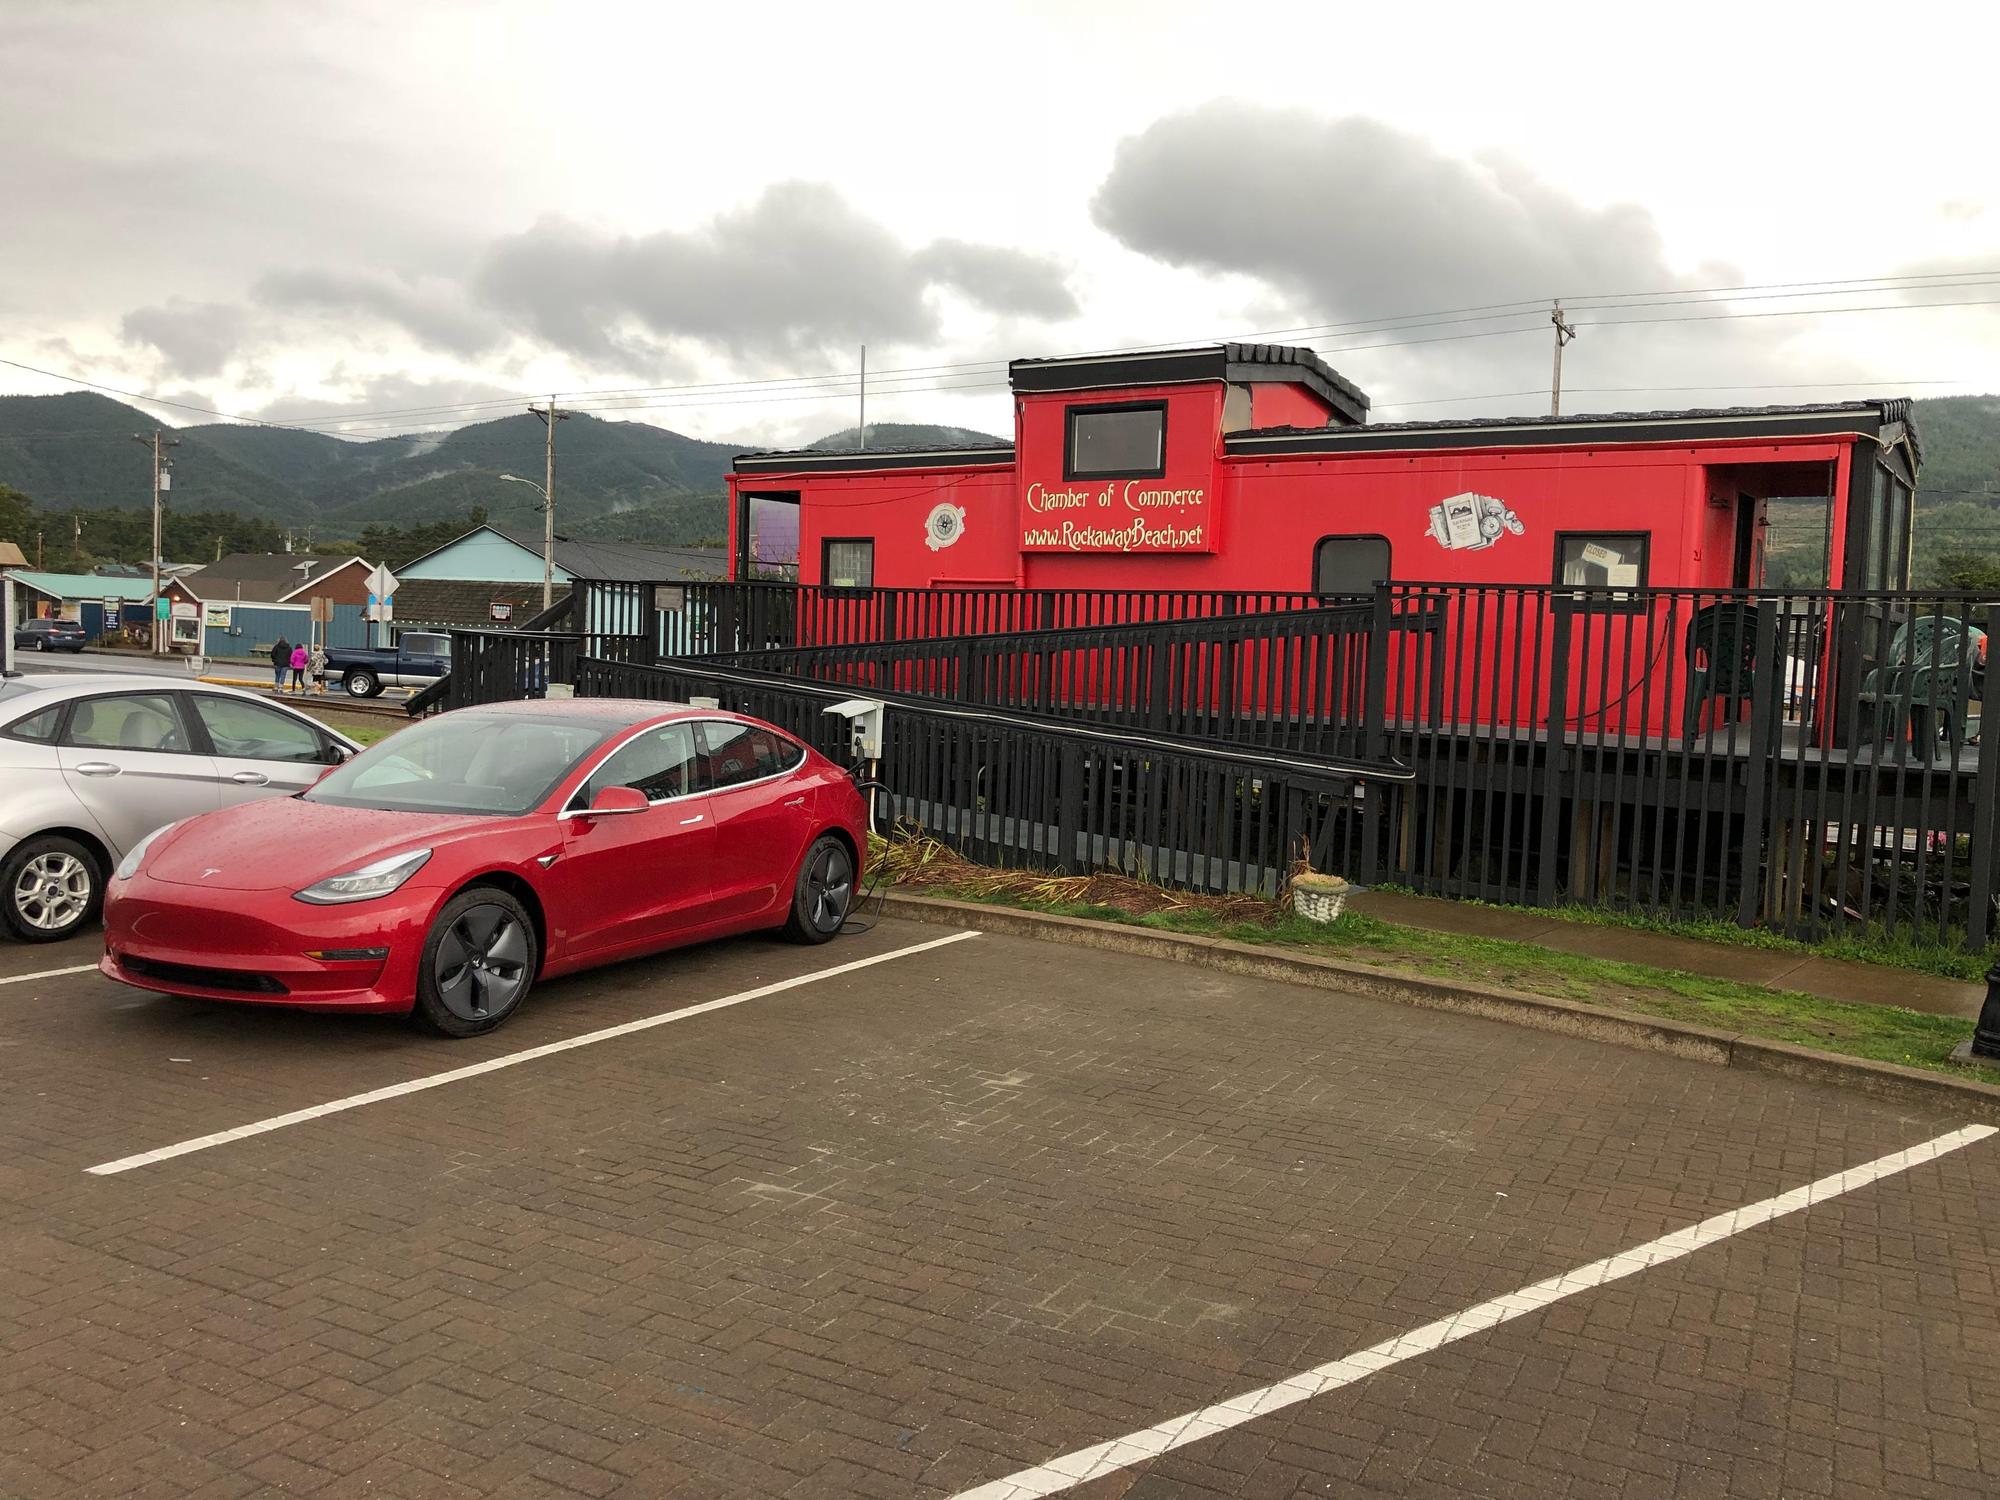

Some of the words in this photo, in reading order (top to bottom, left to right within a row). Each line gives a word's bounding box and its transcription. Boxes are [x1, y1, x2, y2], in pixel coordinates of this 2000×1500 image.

[1027, 483, 1089, 512] Chamber
[1098, 484, 1114, 506] of
[1124, 480, 1203, 511] Commerce
[1024, 518, 1203, 551] www.RockawayBeach.net
[1585, 543, 1608, 559] CLOSED
